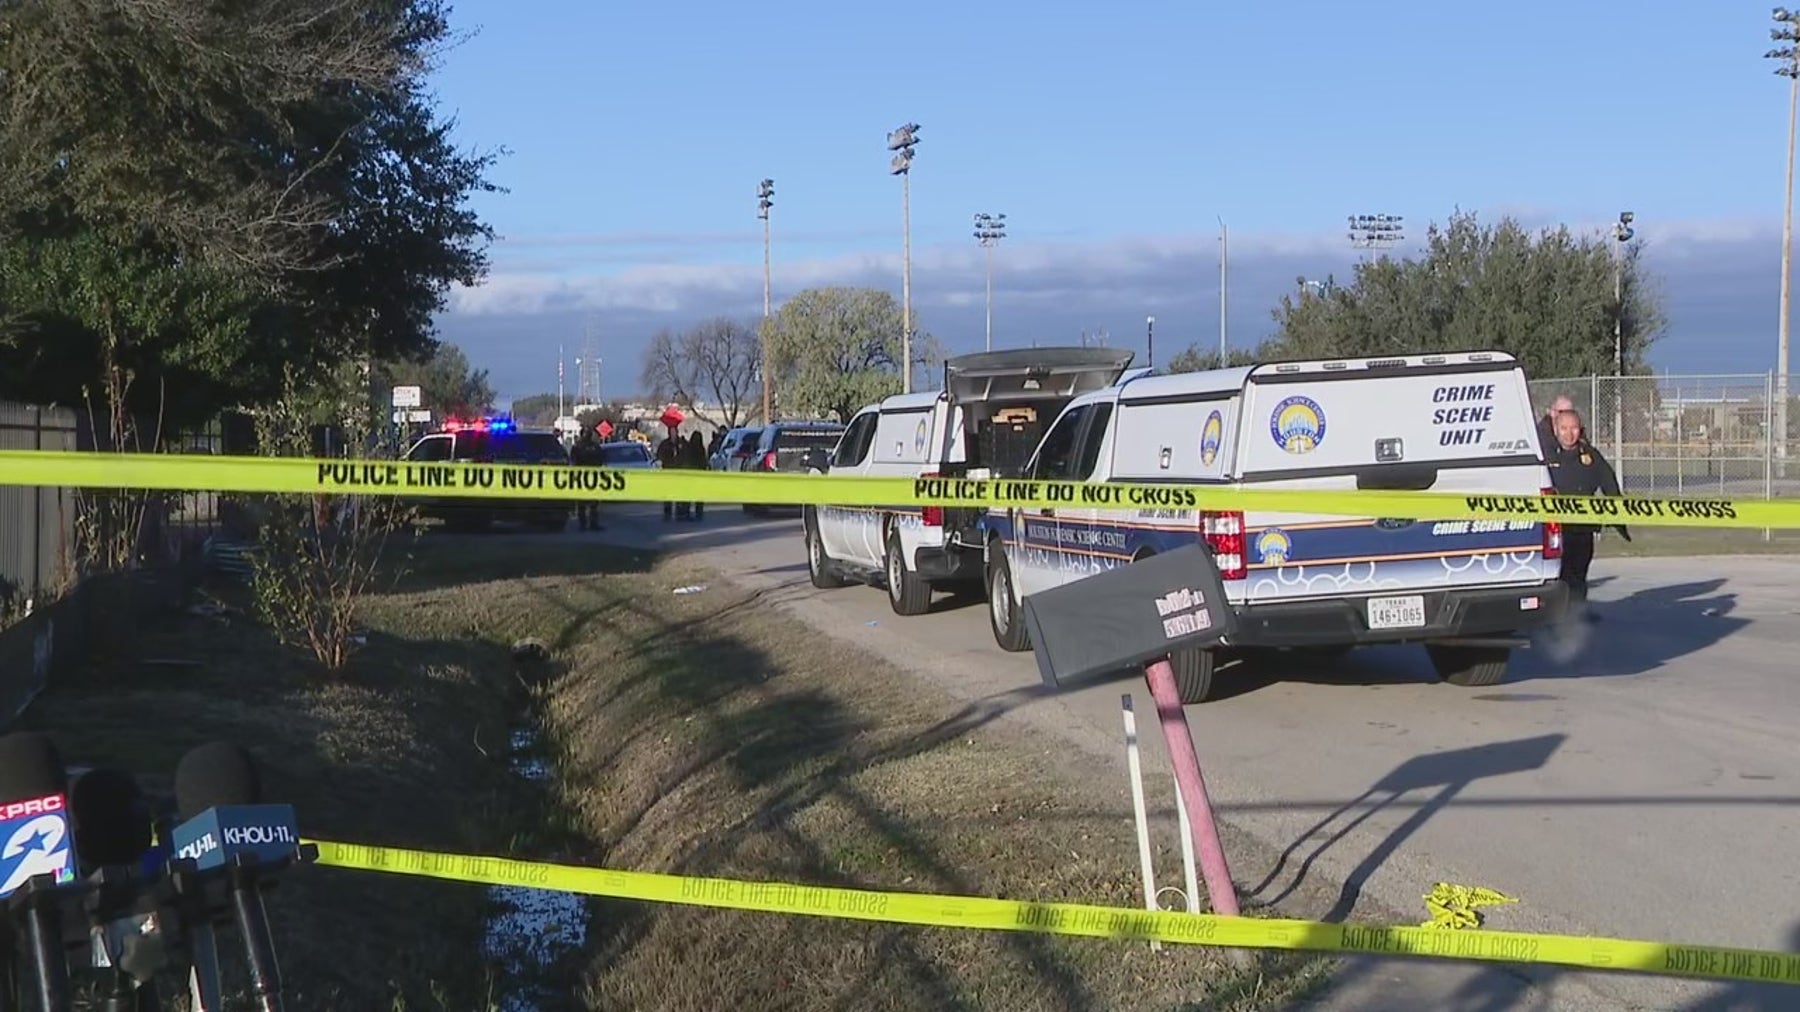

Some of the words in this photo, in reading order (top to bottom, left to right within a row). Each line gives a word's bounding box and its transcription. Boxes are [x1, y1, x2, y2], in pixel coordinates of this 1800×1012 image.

[1432, 384, 1495, 403] CRIME
[1432, 406, 1493, 424] SCENE
[1439, 428, 1486, 446] UNIT
[318, 463, 398, 485] POLICE
[406, 465, 456, 487] LINE
[463, 467, 494, 488] DO
[502, 468, 544, 489] NOT
[553, 469, 626, 491] CROSS
[914, 480, 987, 499] POLICE
[994, 482, 1040, 500] LINE
[1046, 484, 1074, 501] DO
[1082, 485, 1124, 503] NOT
[1129, 487, 1196, 506] CROSS
[1466, 497, 1539, 513] POLICE
[1540, 498, 1588, 514] LINE
[1589, 499, 1618, 515] DO
[1622, 499, 1664, 516] NOT
[1668, 500, 1736, 518] CROSS
[1432, 522, 1469, 536] CRIME
[1471, 521, 1508, 533] SCENE
[1509, 520, 1535, 531] UNIT
